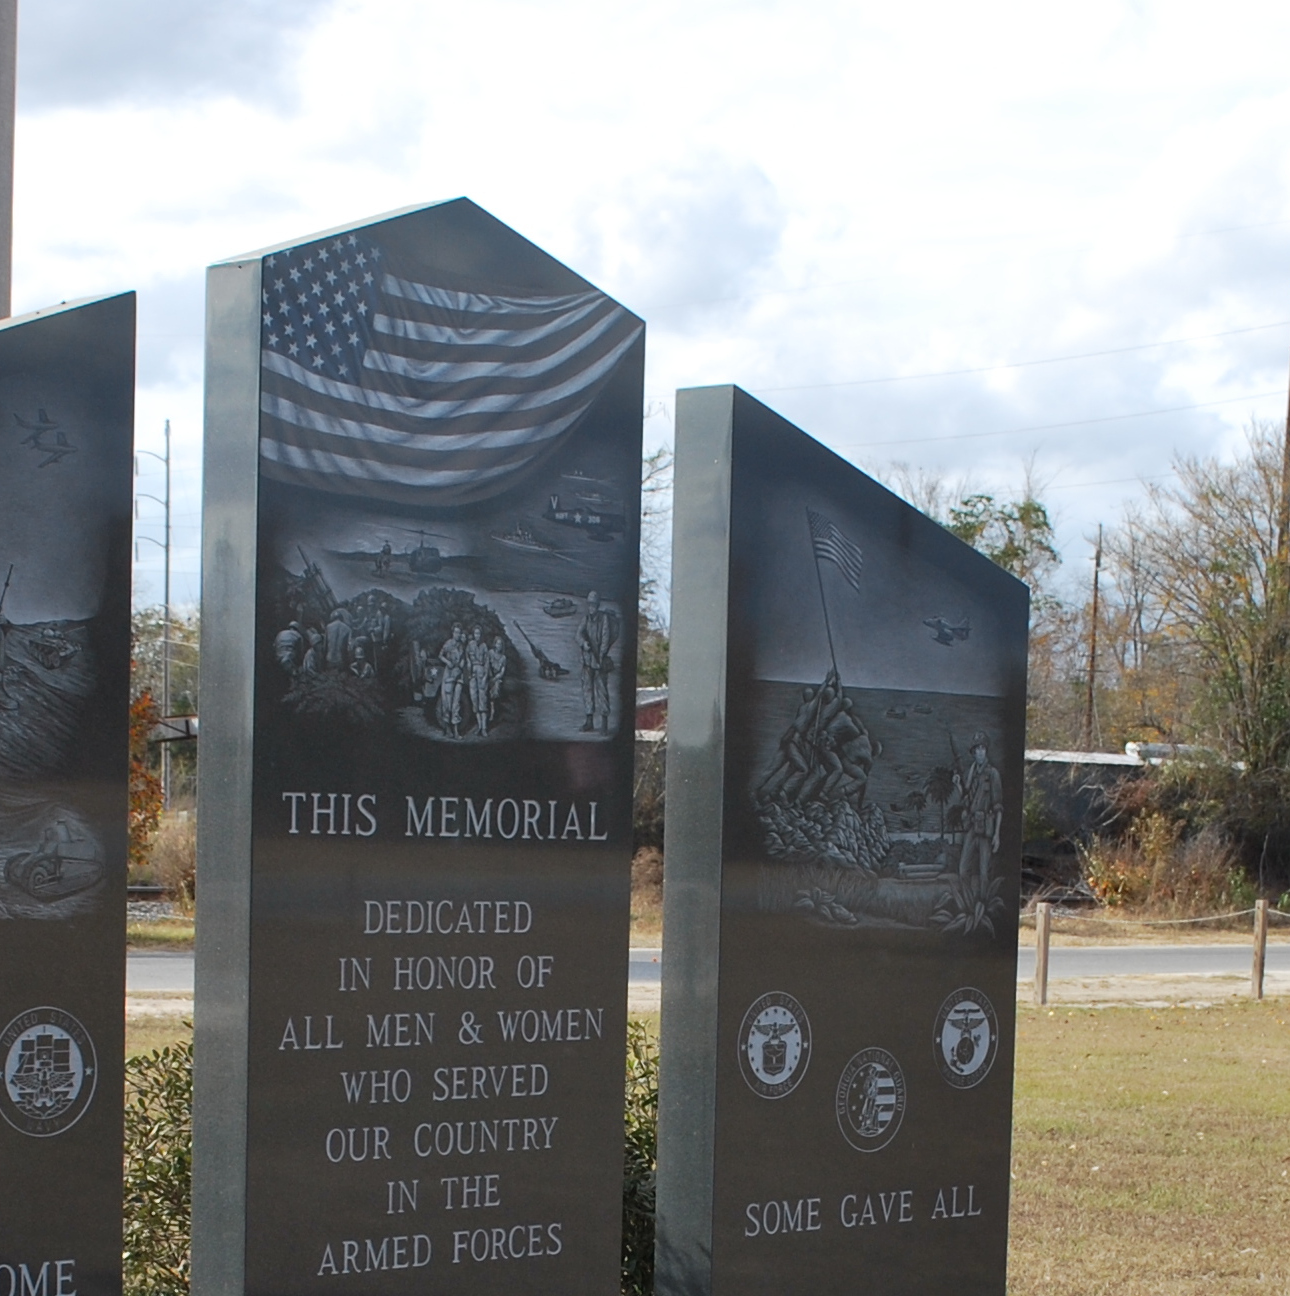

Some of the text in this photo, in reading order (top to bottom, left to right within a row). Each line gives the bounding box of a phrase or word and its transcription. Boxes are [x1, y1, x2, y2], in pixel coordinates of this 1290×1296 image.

[283, 793, 609, 842] THIS MEMORIAL
[365, 901, 533, 935] DEDICATED
[340, 956, 555, 993] IN HONOR OF
[279, 1009, 602, 1052] ALL MEN & WOMEN
[341, 1064, 549, 1105] WHO SERVED
[327, 1117, 559, 1164] OUR COUNTRY
[388, 1175, 502, 1215] IN THE
[745, 1186, 982, 1238] SOME GAVE ALL
[318, 1224, 563, 1277] ARMED FORCES
